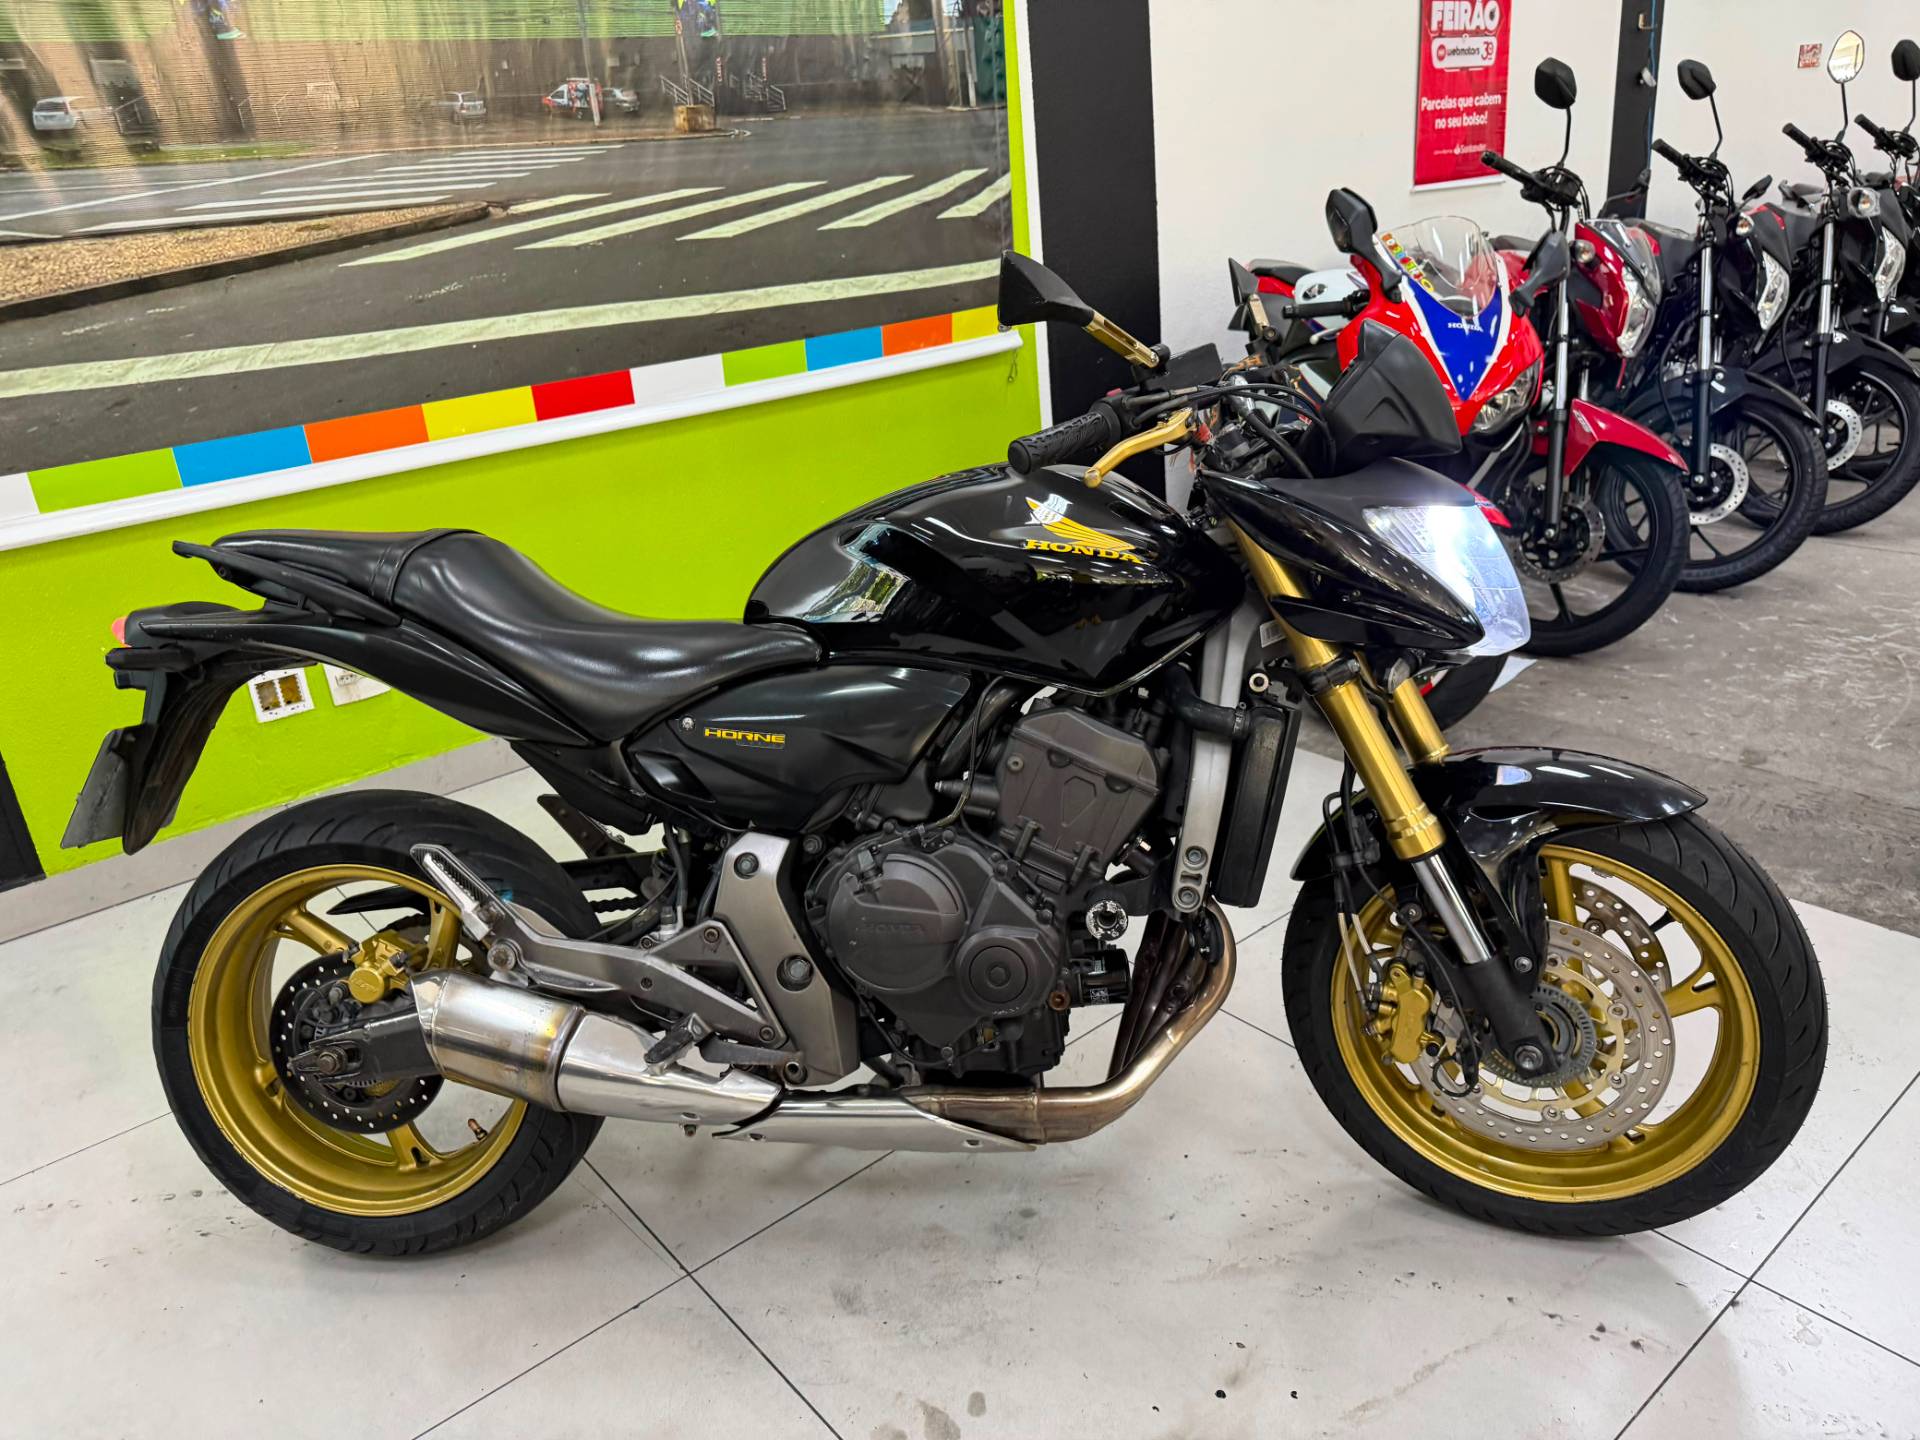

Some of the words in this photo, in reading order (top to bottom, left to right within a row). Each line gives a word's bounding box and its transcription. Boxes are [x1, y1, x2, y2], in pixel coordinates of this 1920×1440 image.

[1431, 0, 1500, 31] FEIRÃO
[1447, 46, 1480, 56] webmotors
[1421, 95, 1457, 111] Parcelas
[1458, 97, 1474, 111] que
[1474, 92, 1502, 106] cabem
[1435, 118, 1446, 130] no
[1448, 117, 1462, 128] seu
[1463, 111, 1488, 126] bolso!
[1025, 538, 1144, 565] HONDA
[704, 727, 786, 744] HORNE
